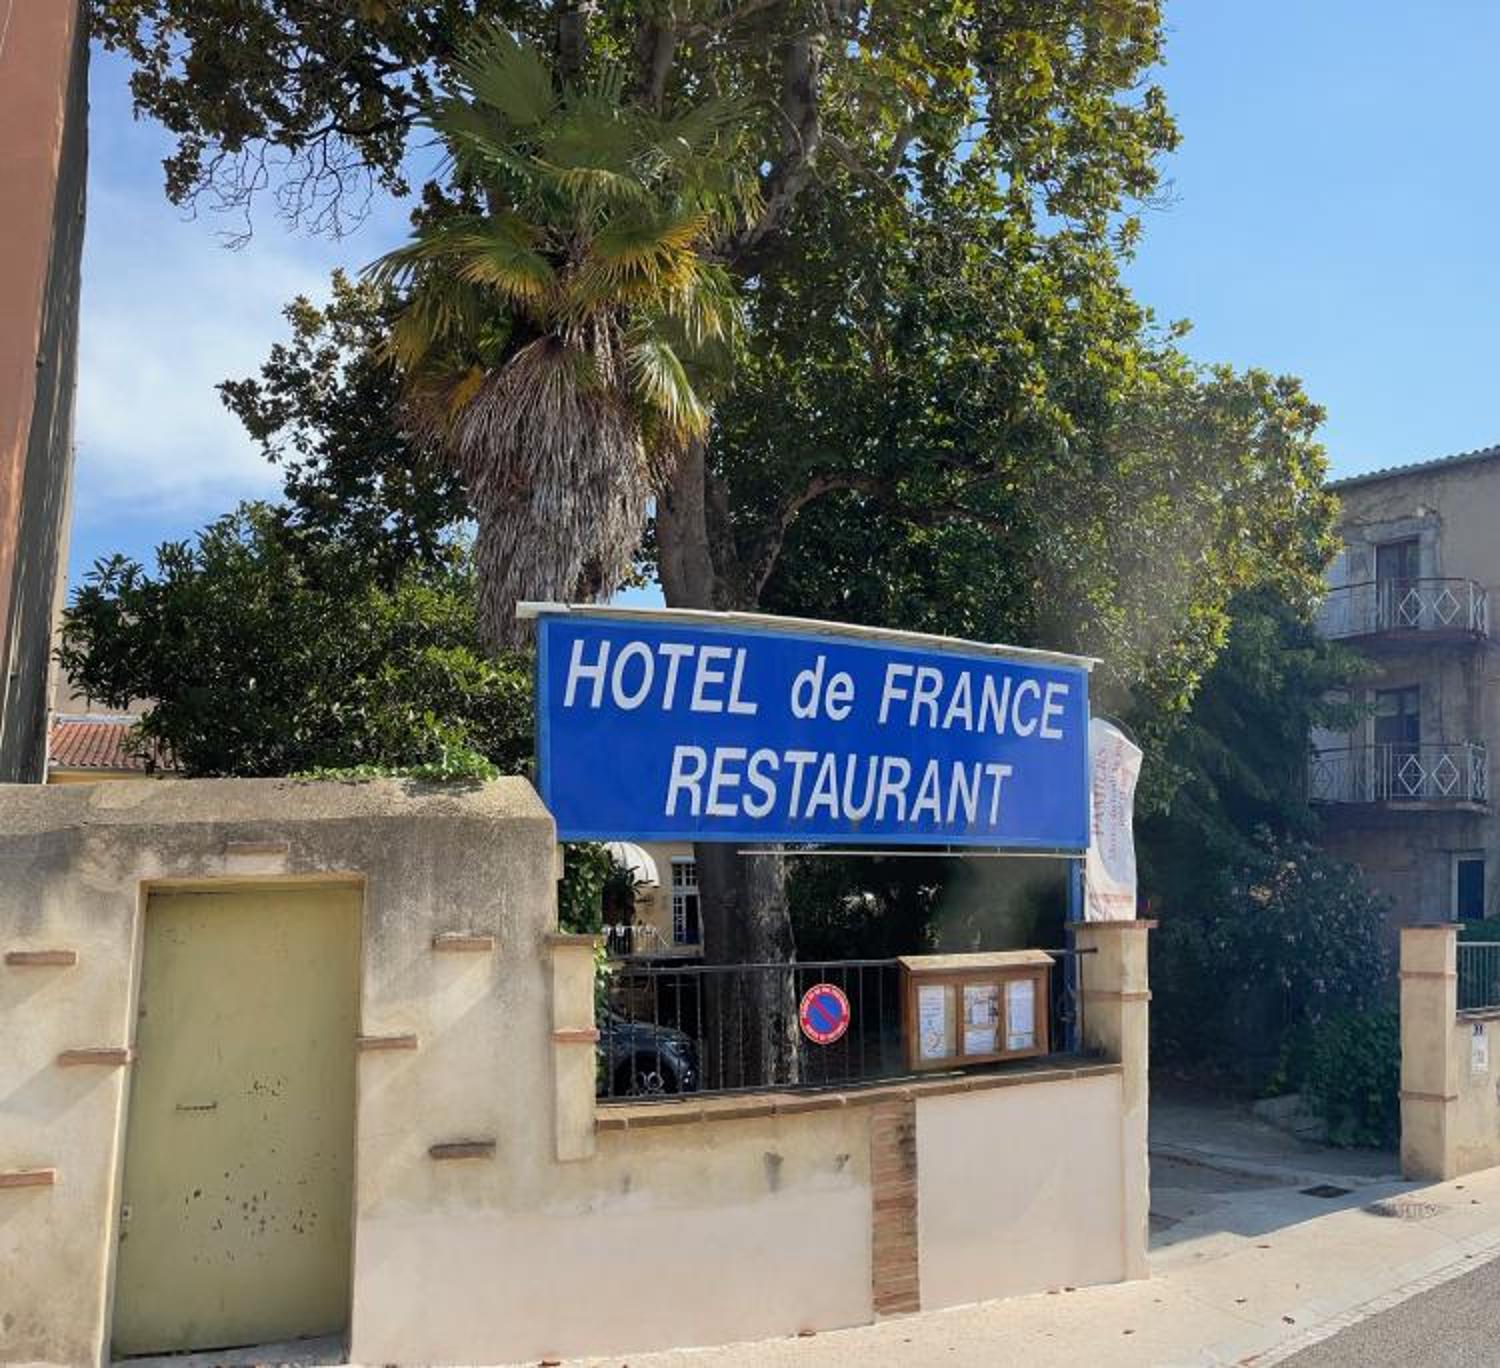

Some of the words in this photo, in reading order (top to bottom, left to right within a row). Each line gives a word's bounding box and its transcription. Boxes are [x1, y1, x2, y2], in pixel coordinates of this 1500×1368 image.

[563, 639, 758, 715] HOTEL
[790, 655, 856, 721] de
[879, 663, 1070, 740] FRANCE
[665, 745, 1013, 826] RESTAURANT
